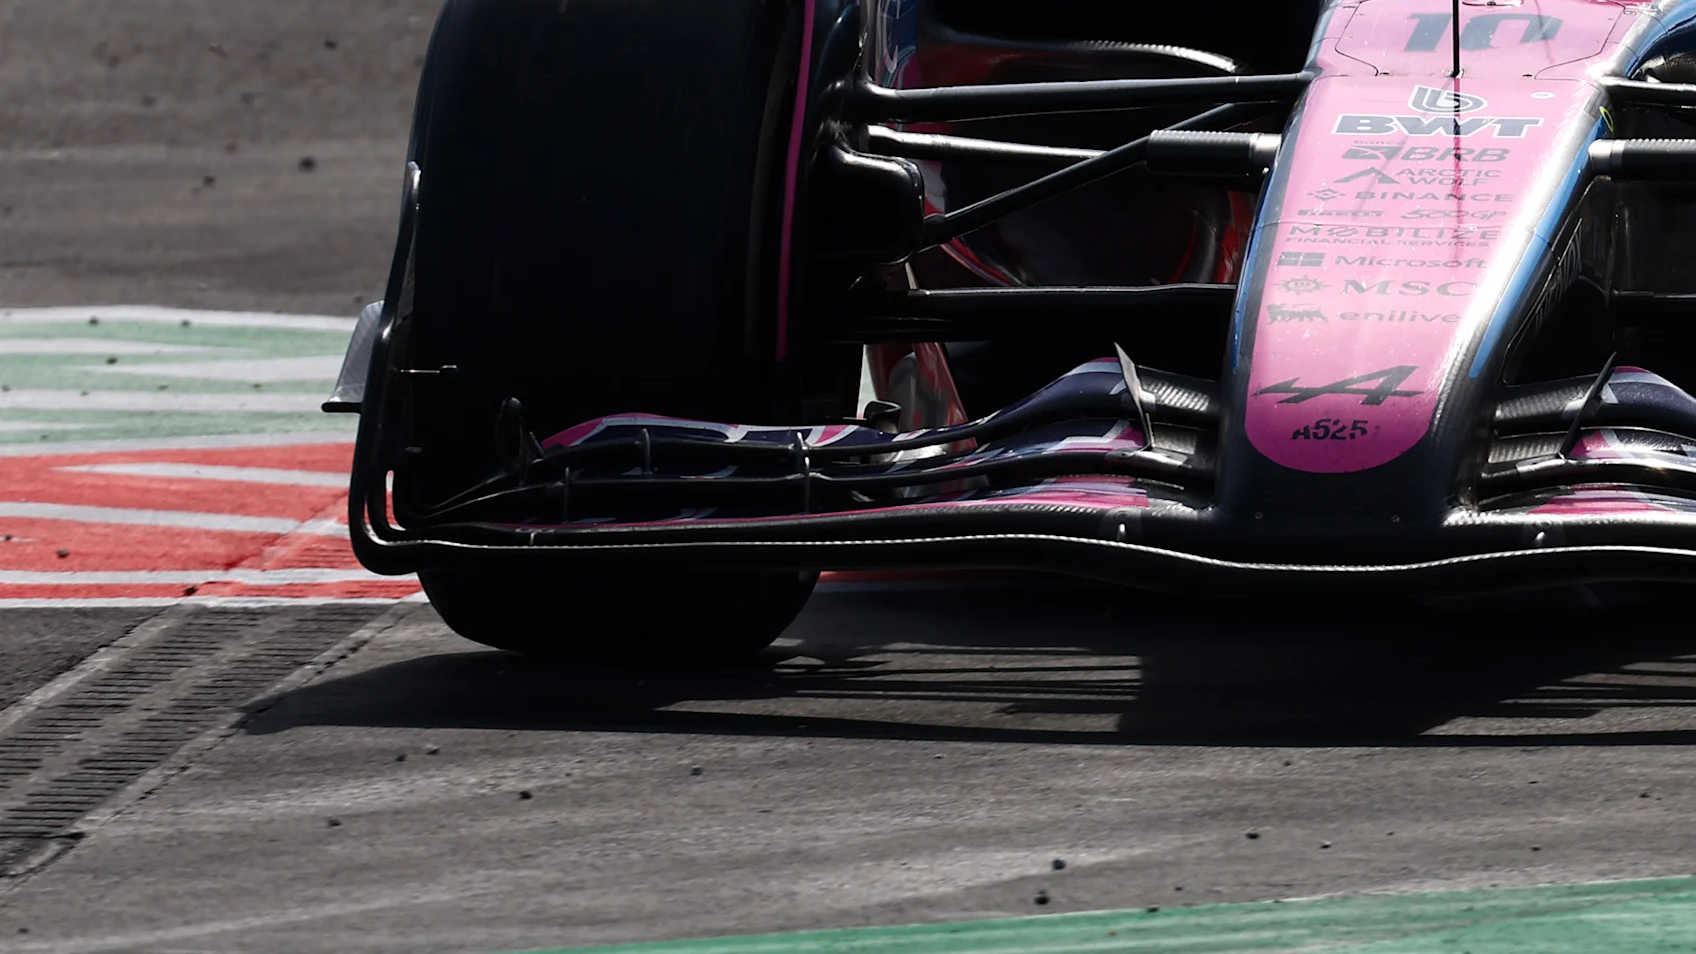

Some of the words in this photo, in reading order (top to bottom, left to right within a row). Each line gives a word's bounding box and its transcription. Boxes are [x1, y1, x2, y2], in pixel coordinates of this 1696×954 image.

[1403, 13, 1564, 52] 10
[1331, 114, 1545, 138] BWT
[1401, 146, 1511, 163] BRB
[1395, 168, 1503, 178] ARCTIC
[1409, 177, 1491, 186] WOLF
[1354, 191, 1516, 203] BINANCE
[1286, 237, 1389, 246] FINANCIAL
[1334, 255, 1488, 268] Microsoft
[1340, 279, 1478, 297] MSC
[1338, 310, 1462, 323] enilive
